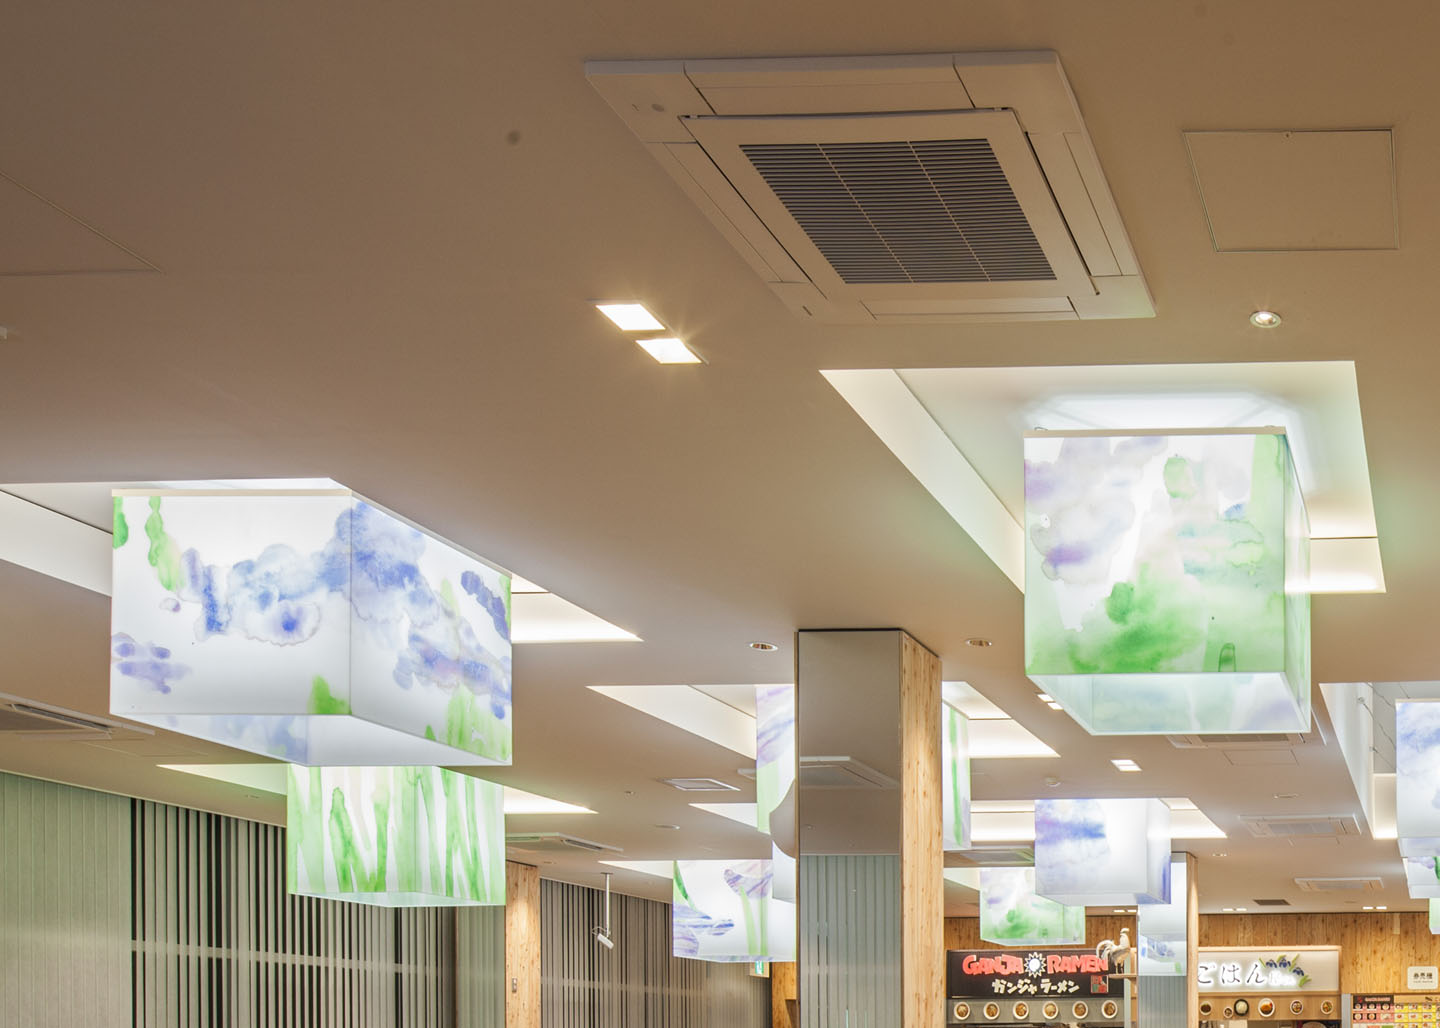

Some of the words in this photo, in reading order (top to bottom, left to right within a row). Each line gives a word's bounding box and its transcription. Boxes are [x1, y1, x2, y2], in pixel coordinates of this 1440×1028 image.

[962, 954, 1024, 976] GANJA
[1047, 954, 1109, 975] RAMEN
[1197, 963, 1267, 985] ごはん
[991, 978, 1038, 995] ガンジャ
[1040, 978, 1080, 994] ラーメン
